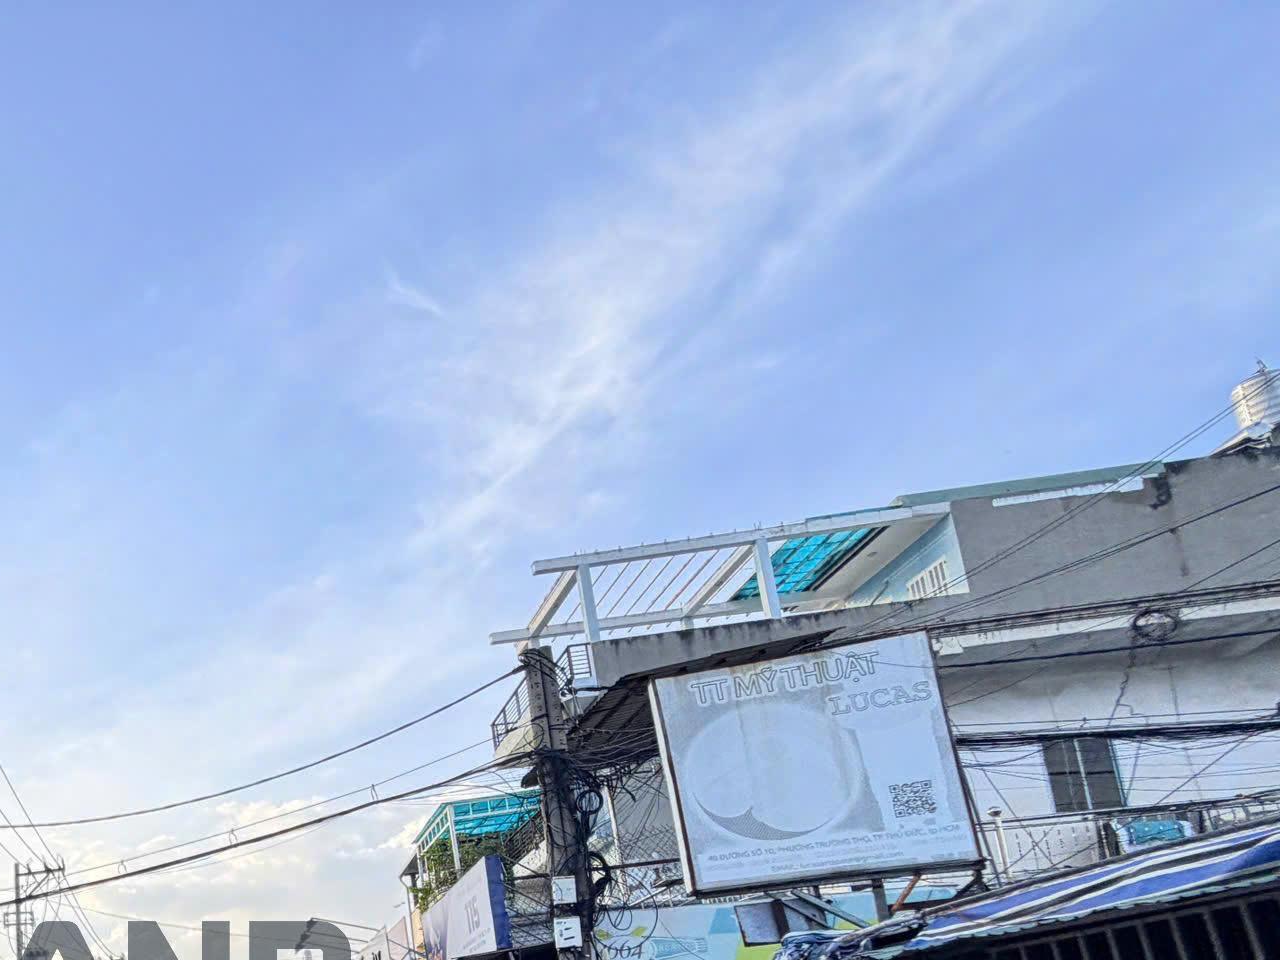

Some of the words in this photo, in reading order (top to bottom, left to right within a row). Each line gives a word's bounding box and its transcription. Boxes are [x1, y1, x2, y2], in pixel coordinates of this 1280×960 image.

[691, 677, 729, 705] TT
[733, 666, 778, 699] MỸ
[780, 650, 879, 690] THUẬT
[827, 680, 934, 716] LUCAS
